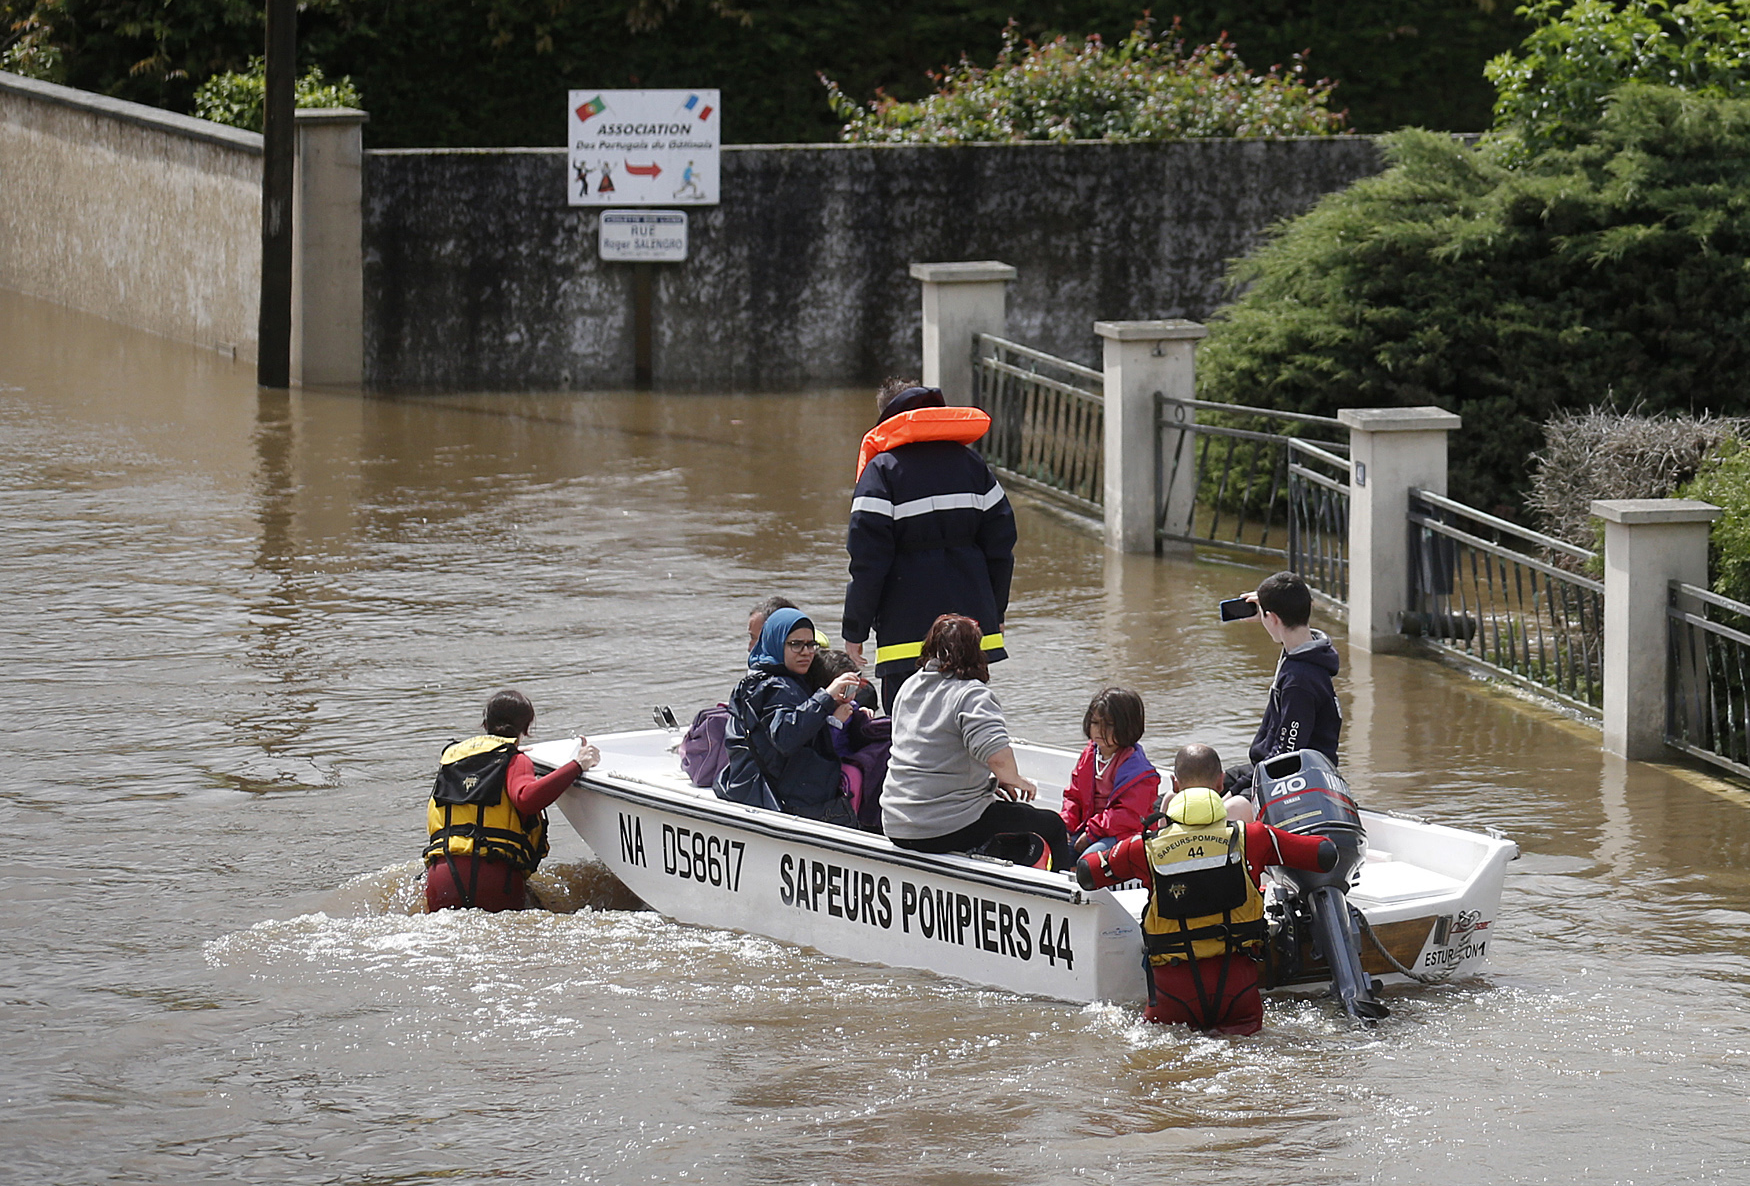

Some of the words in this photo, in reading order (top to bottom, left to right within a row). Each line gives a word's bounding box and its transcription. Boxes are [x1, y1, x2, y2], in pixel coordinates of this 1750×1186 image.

[597, 123, 692, 135] ASSOCIATION
[598, 140, 648, 152] Portugais
[652, 139, 665, 150] du
[630, 224, 656, 236] RUE
[603, 238, 630, 251] Roger
[634, 238, 683, 250] SALENGRO
[1286, 721, 1300, 752] SOUT
[1270, 776, 1307, 797] 40
[618, 812, 648, 869] NA
[663, 823, 746, 893] D58617
[1157, 834, 1230, 860] SAPEURS-POMPIER
[1188, 845, 1205, 859] 44
[779, 853, 893, 929] SAPEURS
[901, 880, 1033, 961] POMPIERS
[1038, 912, 1076, 972] 44
